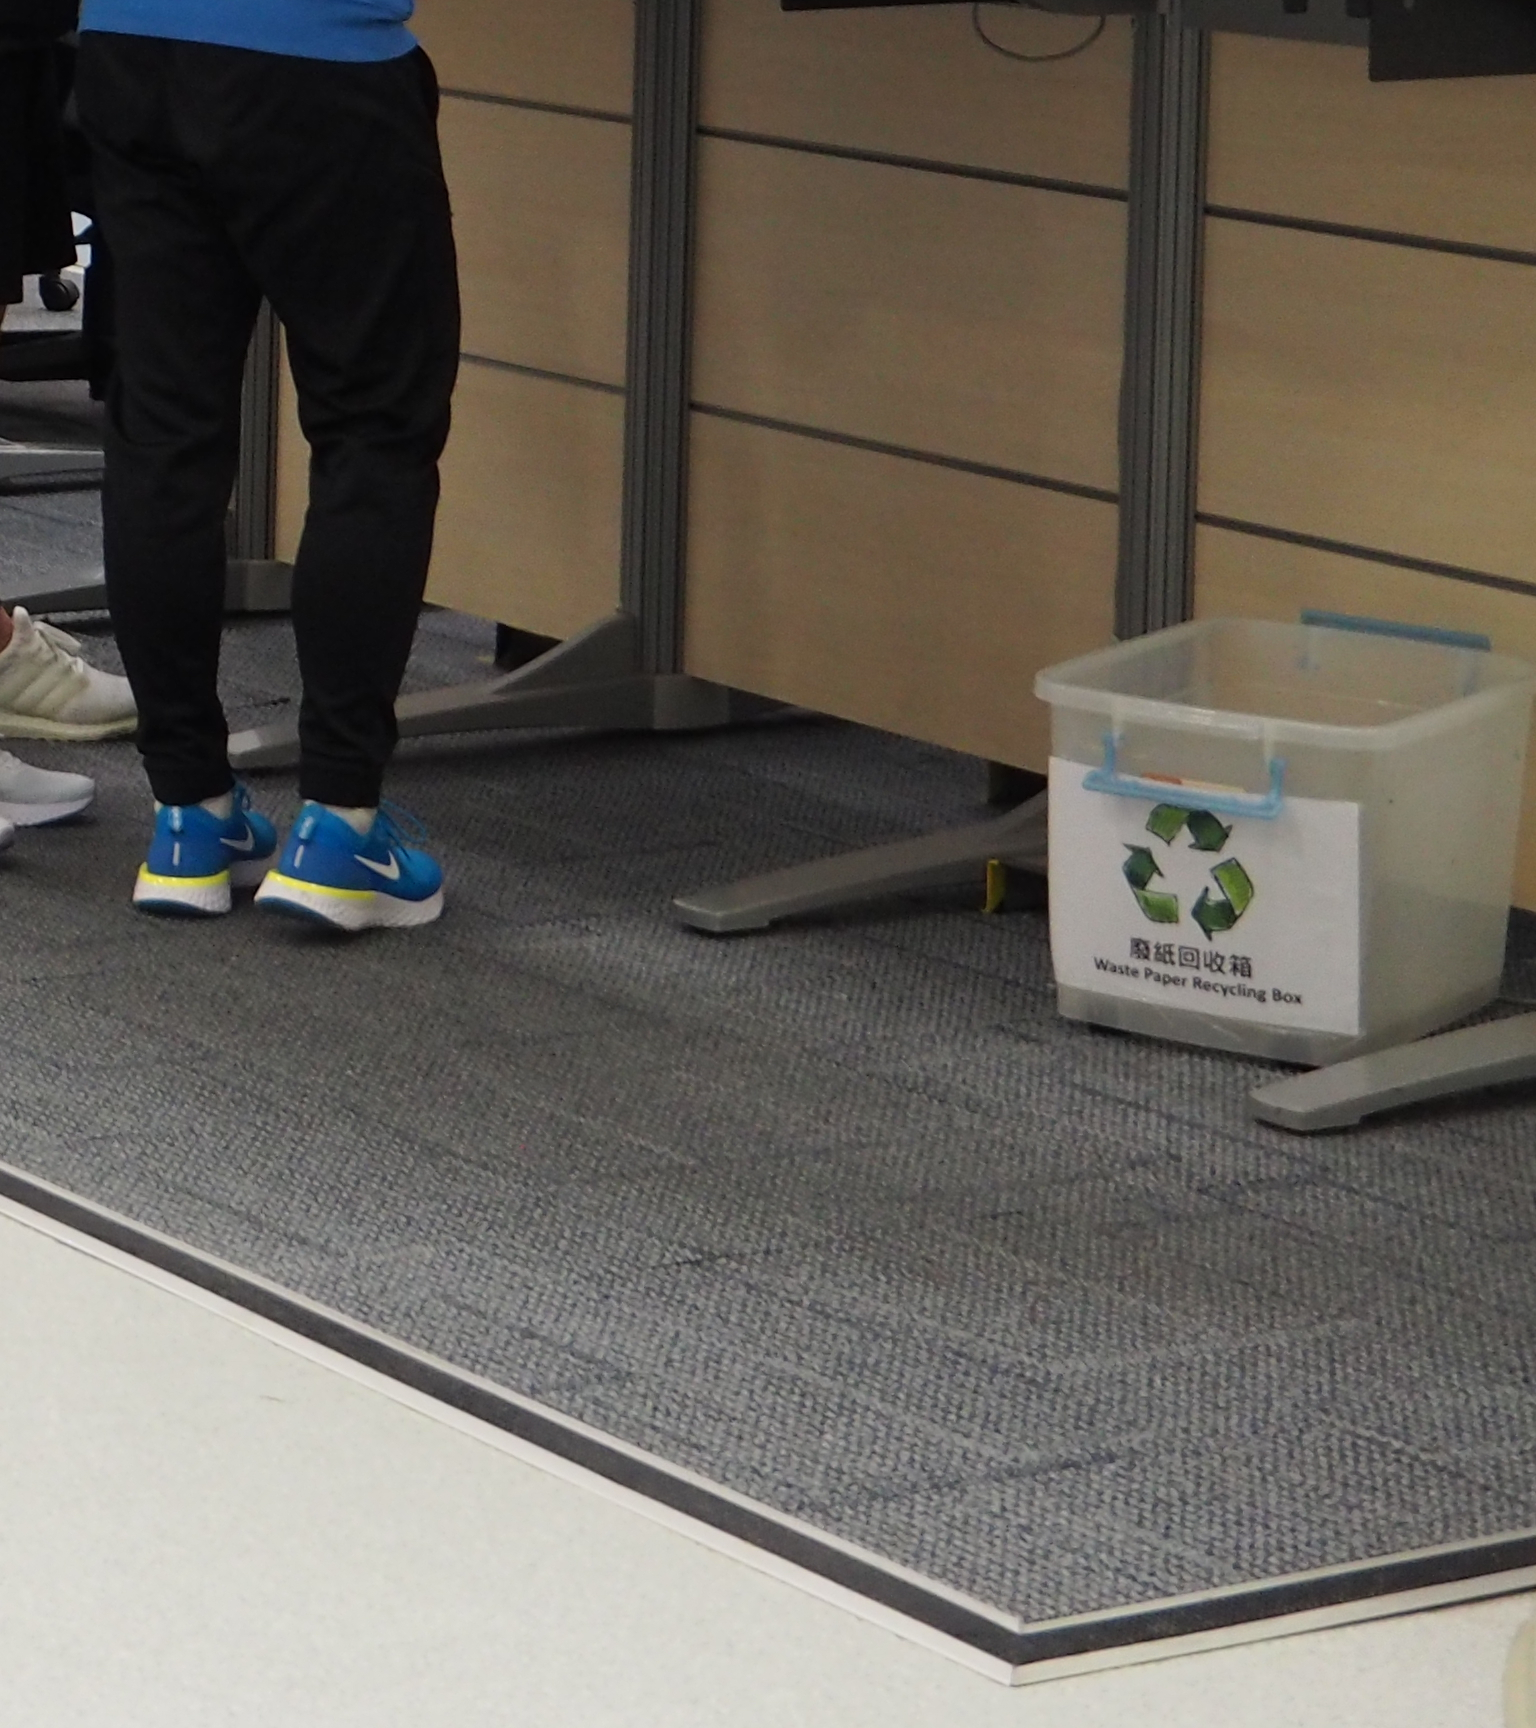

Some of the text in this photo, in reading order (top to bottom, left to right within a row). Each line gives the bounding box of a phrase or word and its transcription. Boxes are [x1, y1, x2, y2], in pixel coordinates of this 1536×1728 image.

[1094, 956, 1304, 1005] Waste Paper Recycling Box
[1130, 937, 1253, 979] 廢紙回收箱
